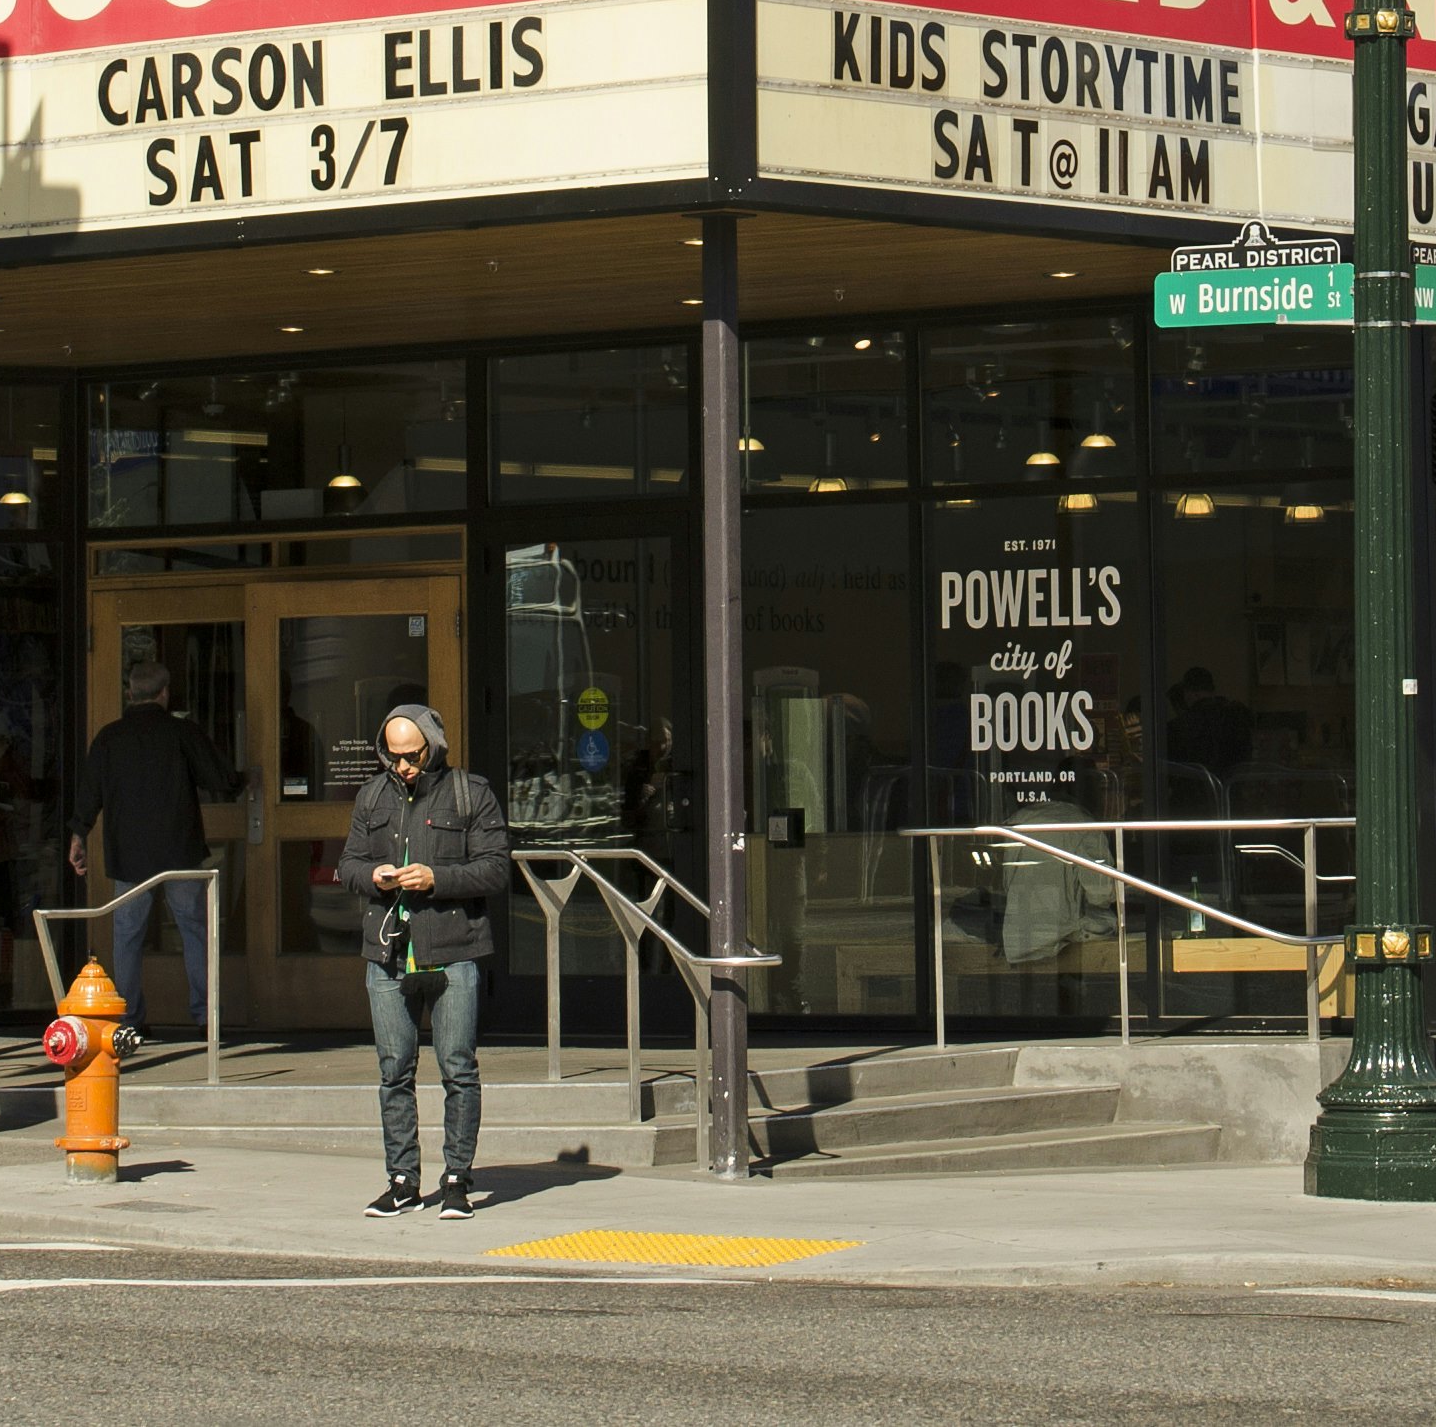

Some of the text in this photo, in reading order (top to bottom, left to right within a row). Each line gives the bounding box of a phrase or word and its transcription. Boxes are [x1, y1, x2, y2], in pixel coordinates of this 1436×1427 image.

[98, 16, 545, 127] CARSON ELLIS
[833, 10, 1242, 125] KIDS STORYTIME
[146, 117, 410, 207] SAT 3/7
[1176, 246, 1335, 271] PEARL DISTRICT
[1327, 270, 1334, 288] 1
[1169, 277, 1313, 315] W Burnside
[1327, 292, 1341, 308] St
[1414, 287, 1435, 309] NW
[1004, 539, 1056, 552] EST. 1971
[941, 565, 1122, 629] POWELL'S
[770, 605, 826, 632] books
[990, 641, 1039, 680] city
[1044, 639, 1073, 680] of
[971, 690, 1094, 752] BOOKS
[990, 770, 1076, 784] PORTLAND, OR
[1017, 791, 1051, 803] U.S.A.
